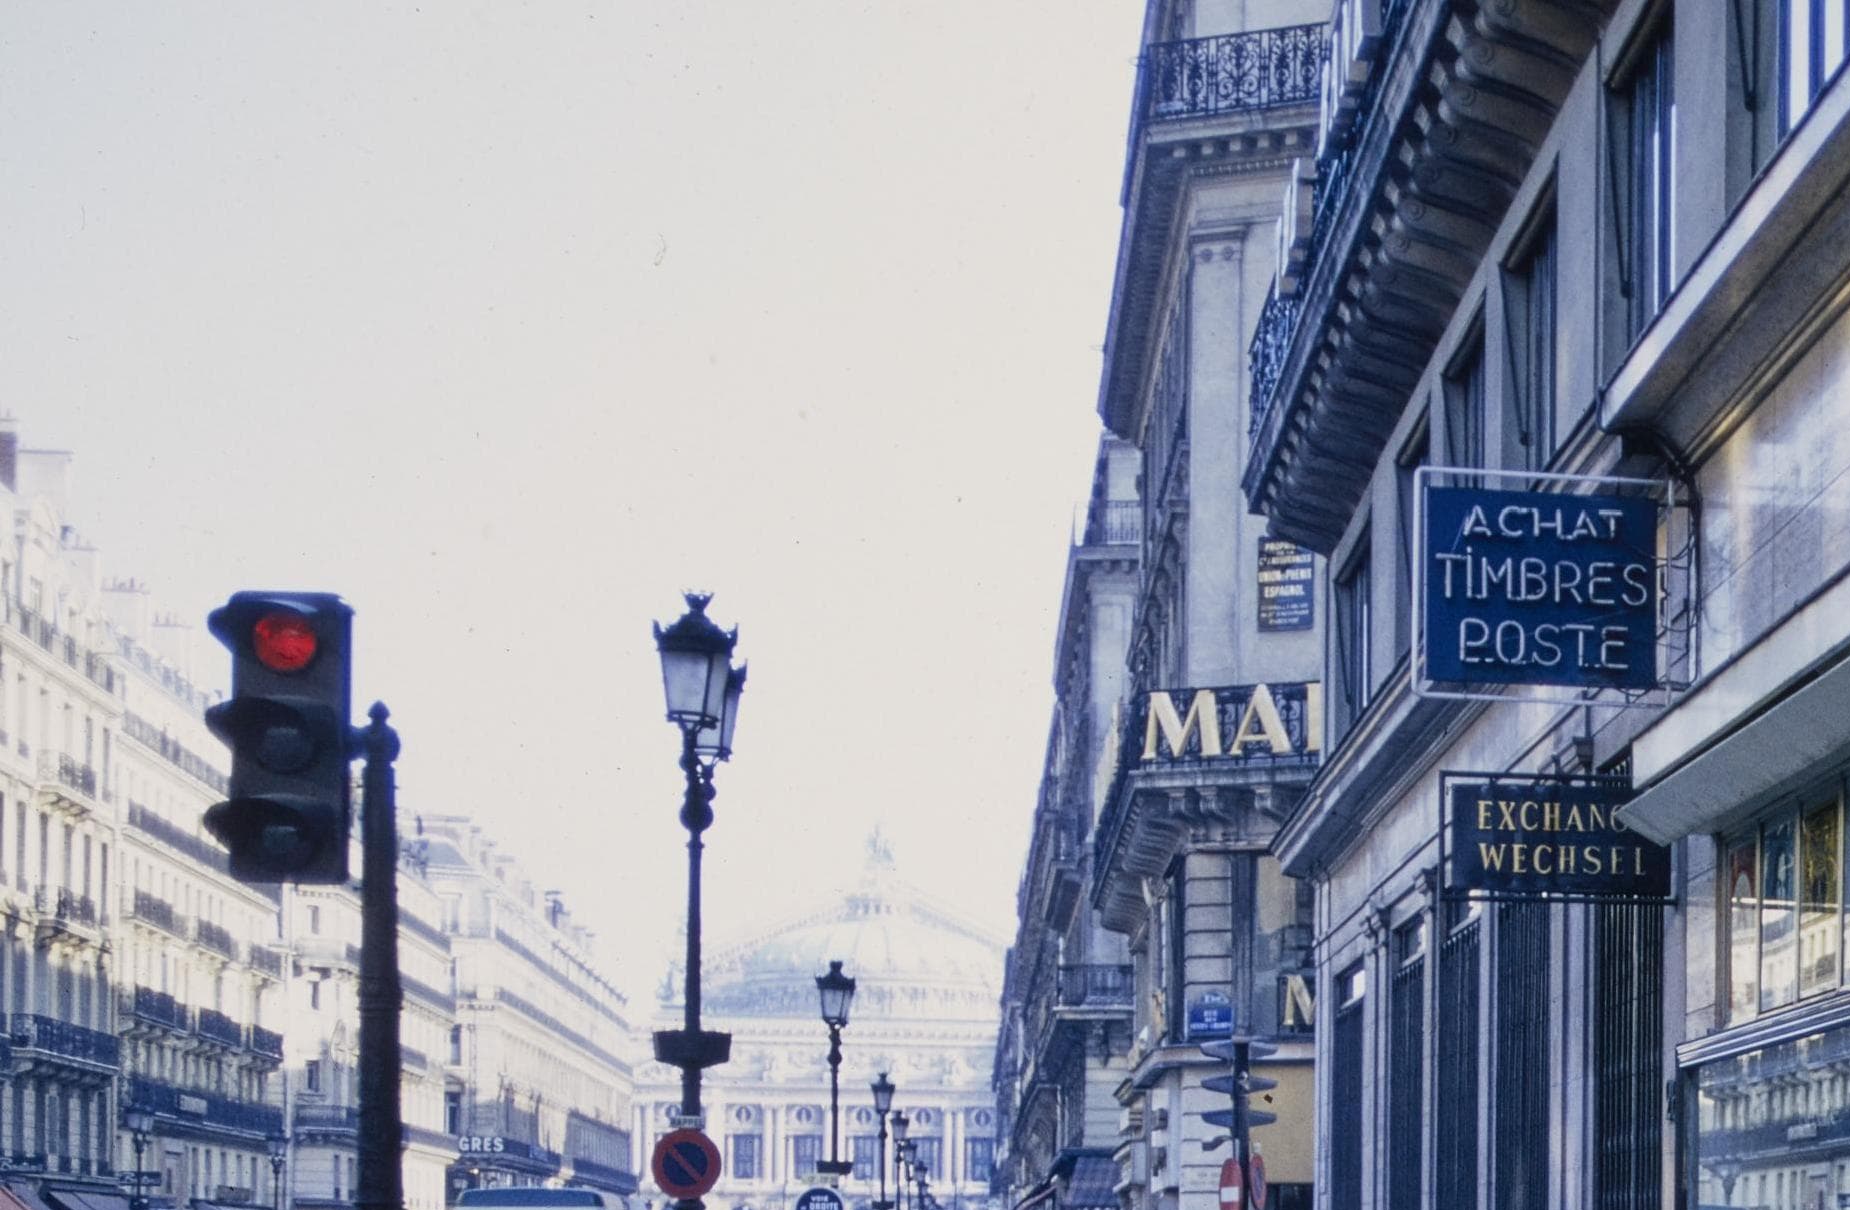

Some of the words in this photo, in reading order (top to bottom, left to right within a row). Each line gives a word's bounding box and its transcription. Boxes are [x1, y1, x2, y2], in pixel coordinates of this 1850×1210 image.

[1463, 504, 1624, 541] ACHAT
[1434, 546, 1649, 607] TIMBRES
[1459, 617, 1630, 671] POSTE
[1478, 842, 1647, 876] WECHSEL
